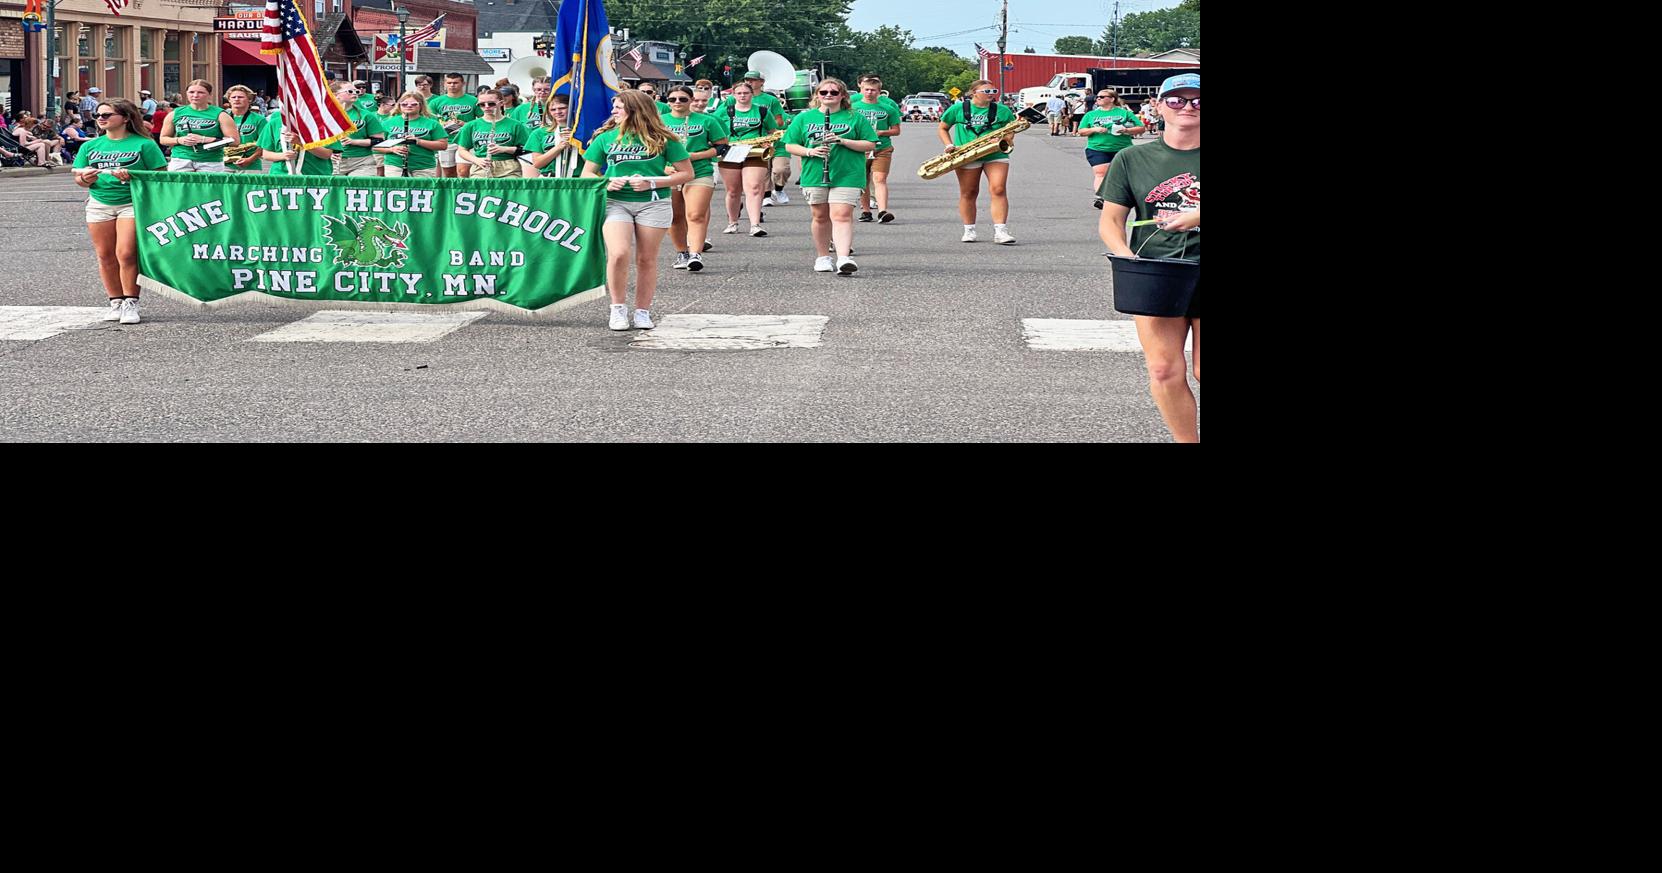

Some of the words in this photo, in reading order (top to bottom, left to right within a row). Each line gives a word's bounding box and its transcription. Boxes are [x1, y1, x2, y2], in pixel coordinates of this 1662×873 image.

[146, 199, 230, 246] PINE
[246, 188, 328, 213] CITY
[345, 189, 434, 213] HIGH
[454, 193, 585, 252] SCHOOL
[192, 244, 323, 263] MARCHING
[449, 250, 525, 267] BAND
[231, 268, 317, 293] PINE
[442, 273, 507, 296] MN.
